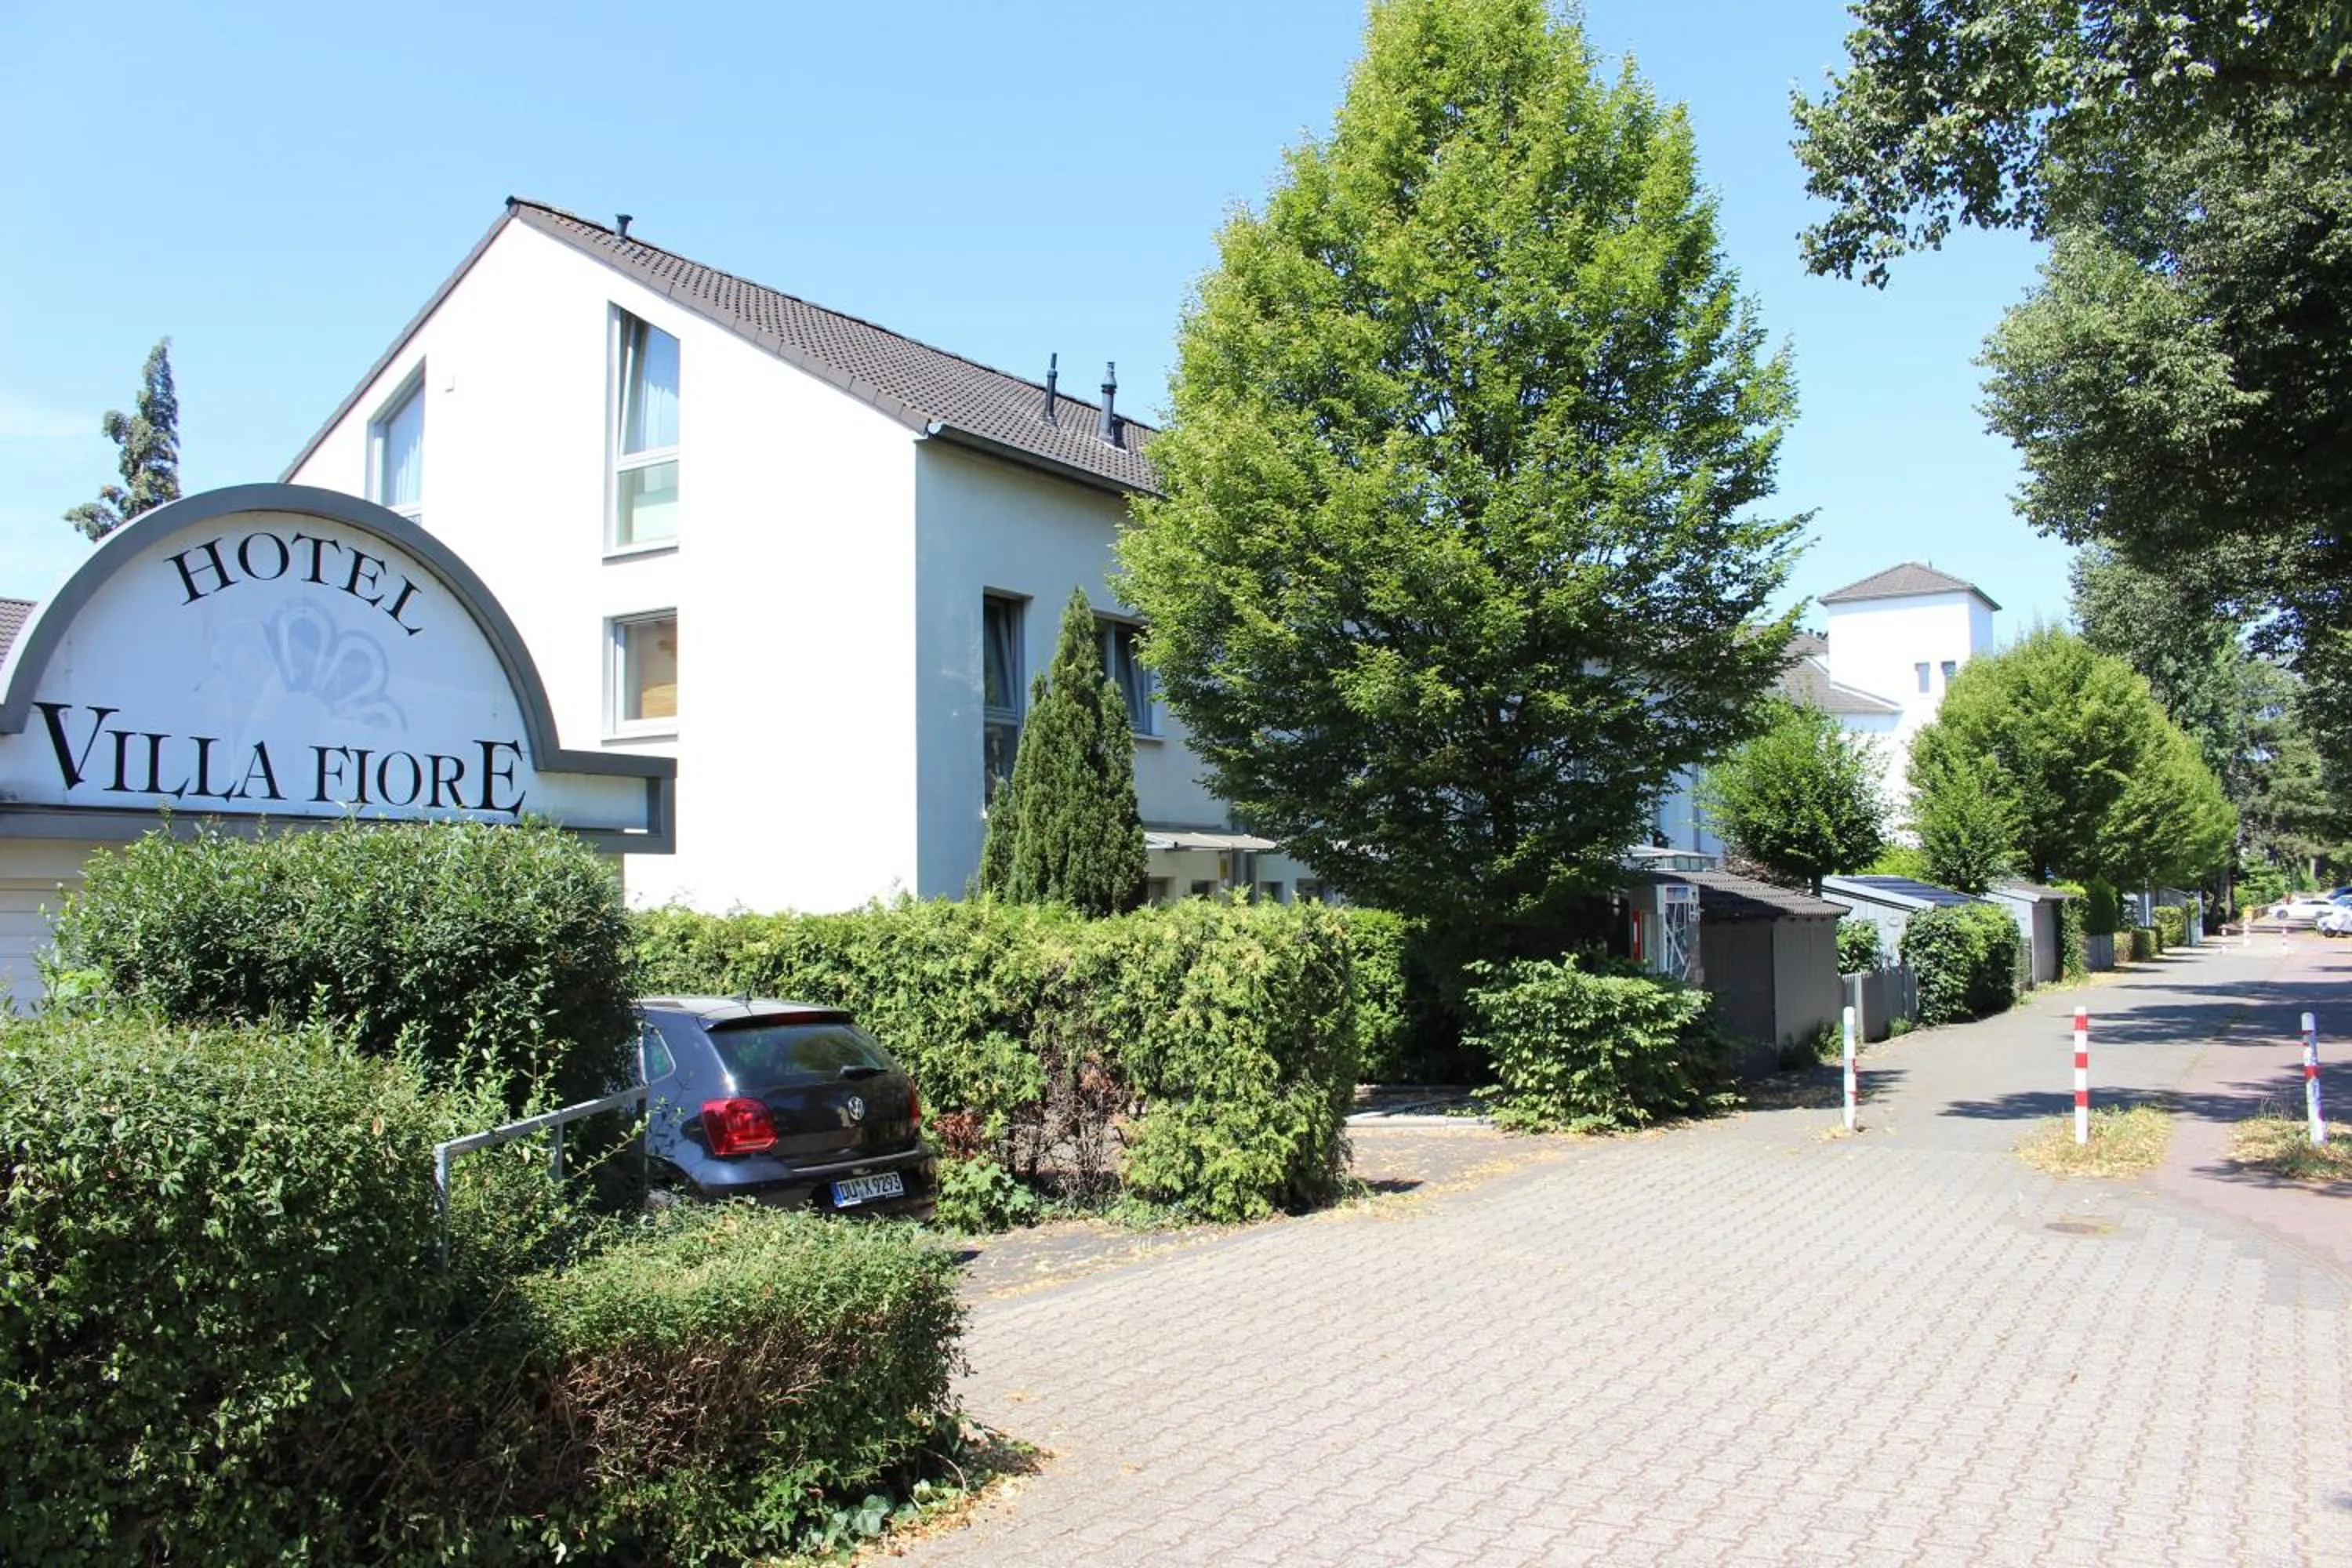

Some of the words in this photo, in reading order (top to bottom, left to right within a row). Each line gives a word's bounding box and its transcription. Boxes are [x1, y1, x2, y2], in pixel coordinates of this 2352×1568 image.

[163, 532, 423, 636] HOTEL
[32, 702, 287, 800] VILLA
[307, 739, 526, 818] FIORE
